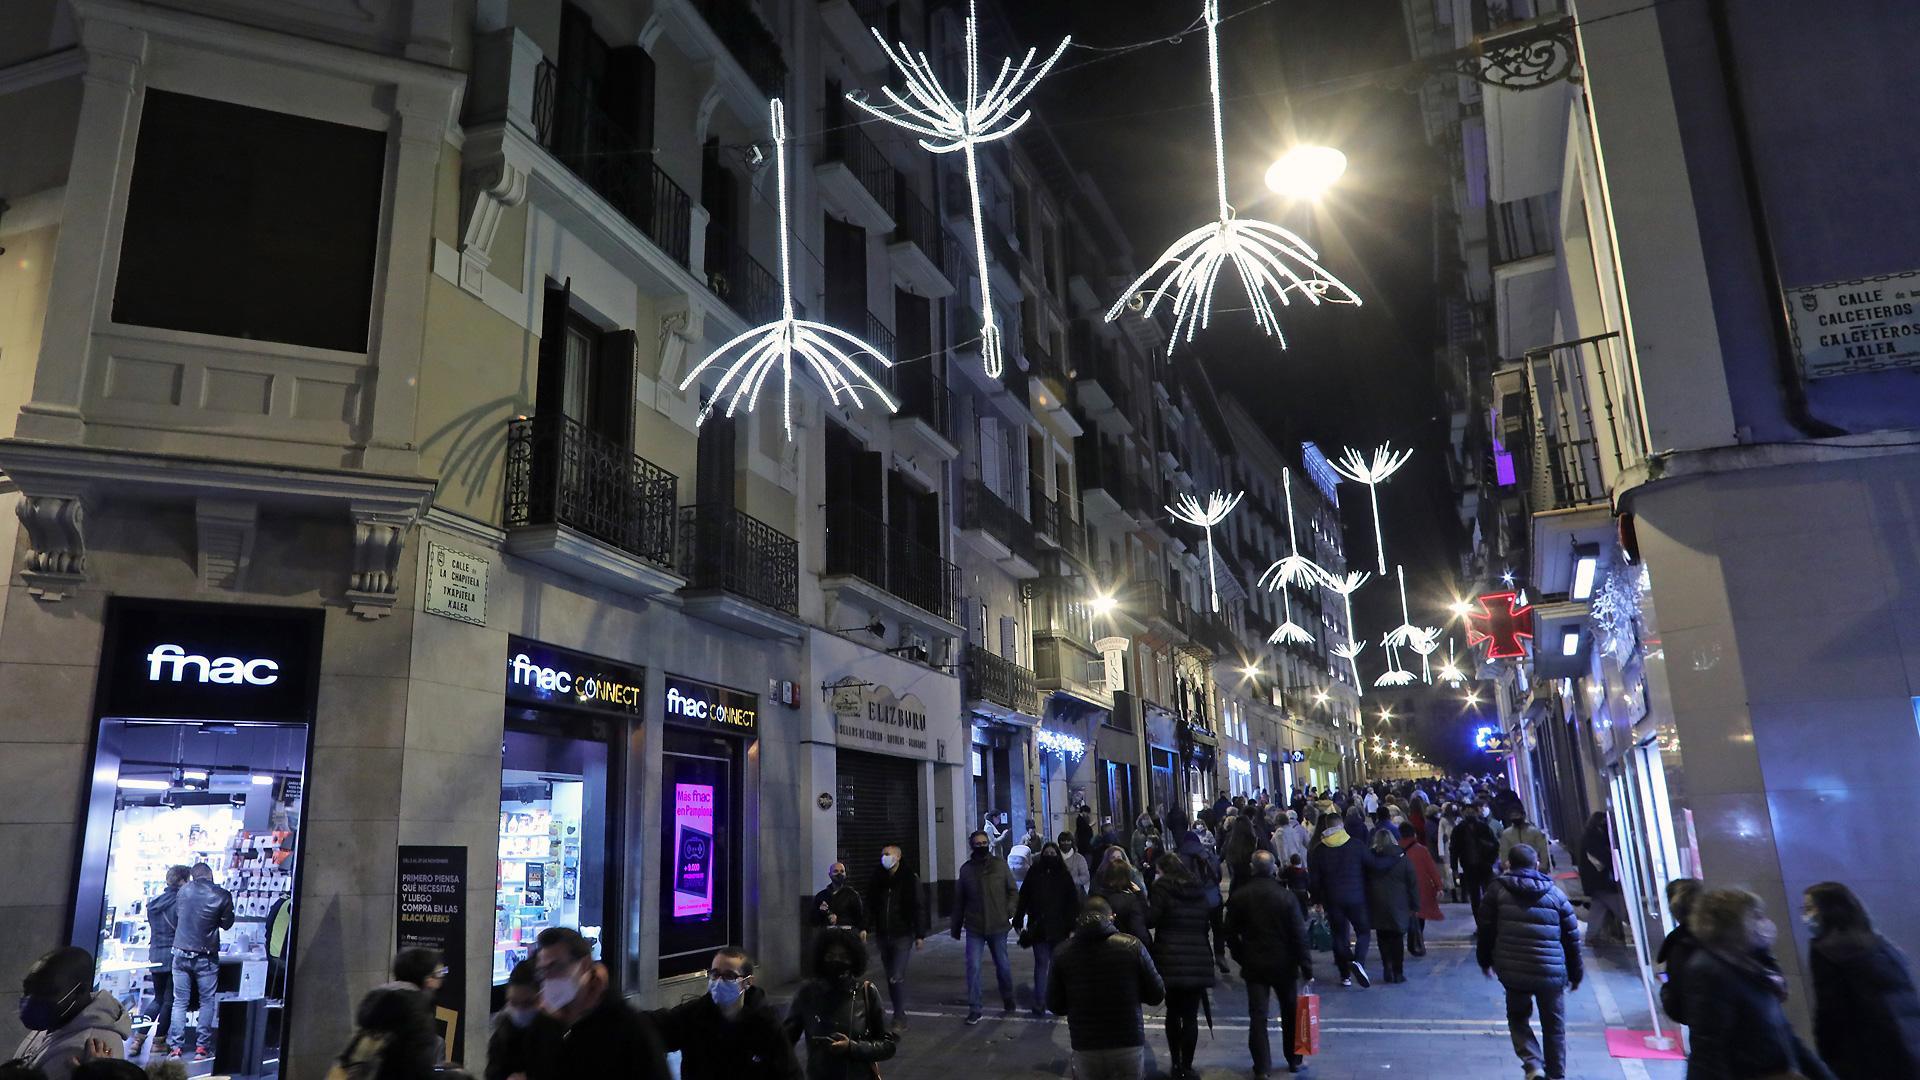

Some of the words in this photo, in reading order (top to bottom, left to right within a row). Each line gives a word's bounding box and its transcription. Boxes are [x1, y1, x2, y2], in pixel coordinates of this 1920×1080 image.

[1838, 290, 1884, 307] CALLE
[1818, 303, 1913, 327] CALCETEROS
[1844, 341, 1897, 359] KALEA
[451, 559, 470, 573] CALLE
[440, 569, 447, 578] LA
[451, 571, 480, 587] CHAPITELA
[443, 586, 475, 602] TXAPITELA
[147, 644, 279, 686] fnac
[513, 653, 571, 693] fnac
[575, 675, 640, 707] CONNECT
[667, 687, 708, 720] fnac
[709, 703, 755, 729] CONNECT
[867, 701, 927, 731] ELIZBURU
[692, 790, 711, 802] fnac
[402, 874, 433, 882] PRIMERO
[434, 875, 460, 884] PIENSA
[402, 883, 417, 892] QUÉ
[418, 885, 456, 893] NECESITAS
[402, 894, 407, 902] Y
[408, 894, 432, 903] LUEGO
[402, 904, 432, 912] COMPRA
[434, 905, 443, 913] EN
[445, 905, 458, 914] LAS
[401, 914, 425, 922] BLACK
